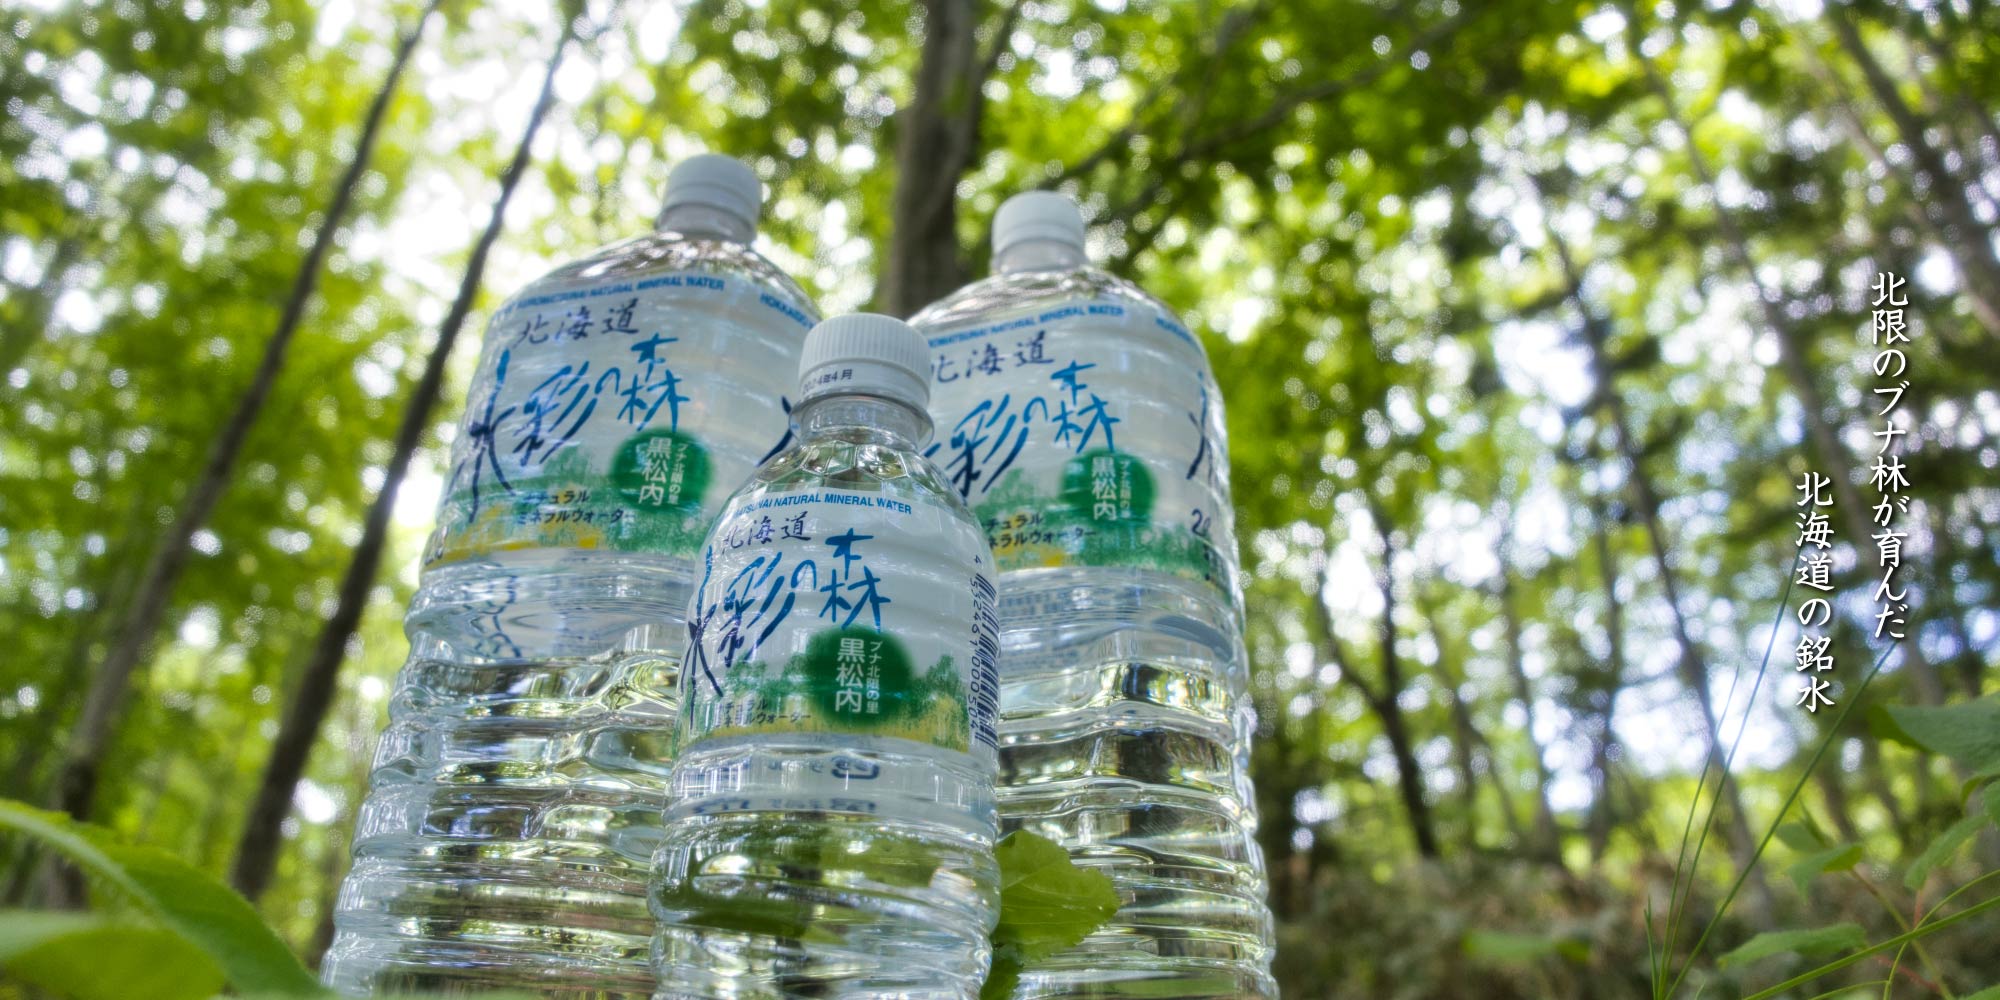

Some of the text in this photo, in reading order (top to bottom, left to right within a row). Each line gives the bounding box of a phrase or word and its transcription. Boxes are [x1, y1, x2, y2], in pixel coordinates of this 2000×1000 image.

[636, 276, 682, 291] MINERAL
[686, 276, 726, 291] WATER
[512, 298, 640, 348] 北海道
[1039, 306, 1085, 323] MINERAL
[1088, 305, 1124, 317] WATER
[931, 330, 1055, 384] 北海道
[924, 360, 1121, 498] 彩の森
[638, 436, 673, 506] 黒松内
[1091, 456, 1117, 520] 黒松内
[775, 494, 821, 507] NATURAL
[825, 493, 874, 507] MINERAL
[877, 498, 912, 515] WATER
[722, 511, 811, 552] 北海道
[834, 637, 866, 714] 黒松内
[866, 640, 883, 715] ブナ北限の里
